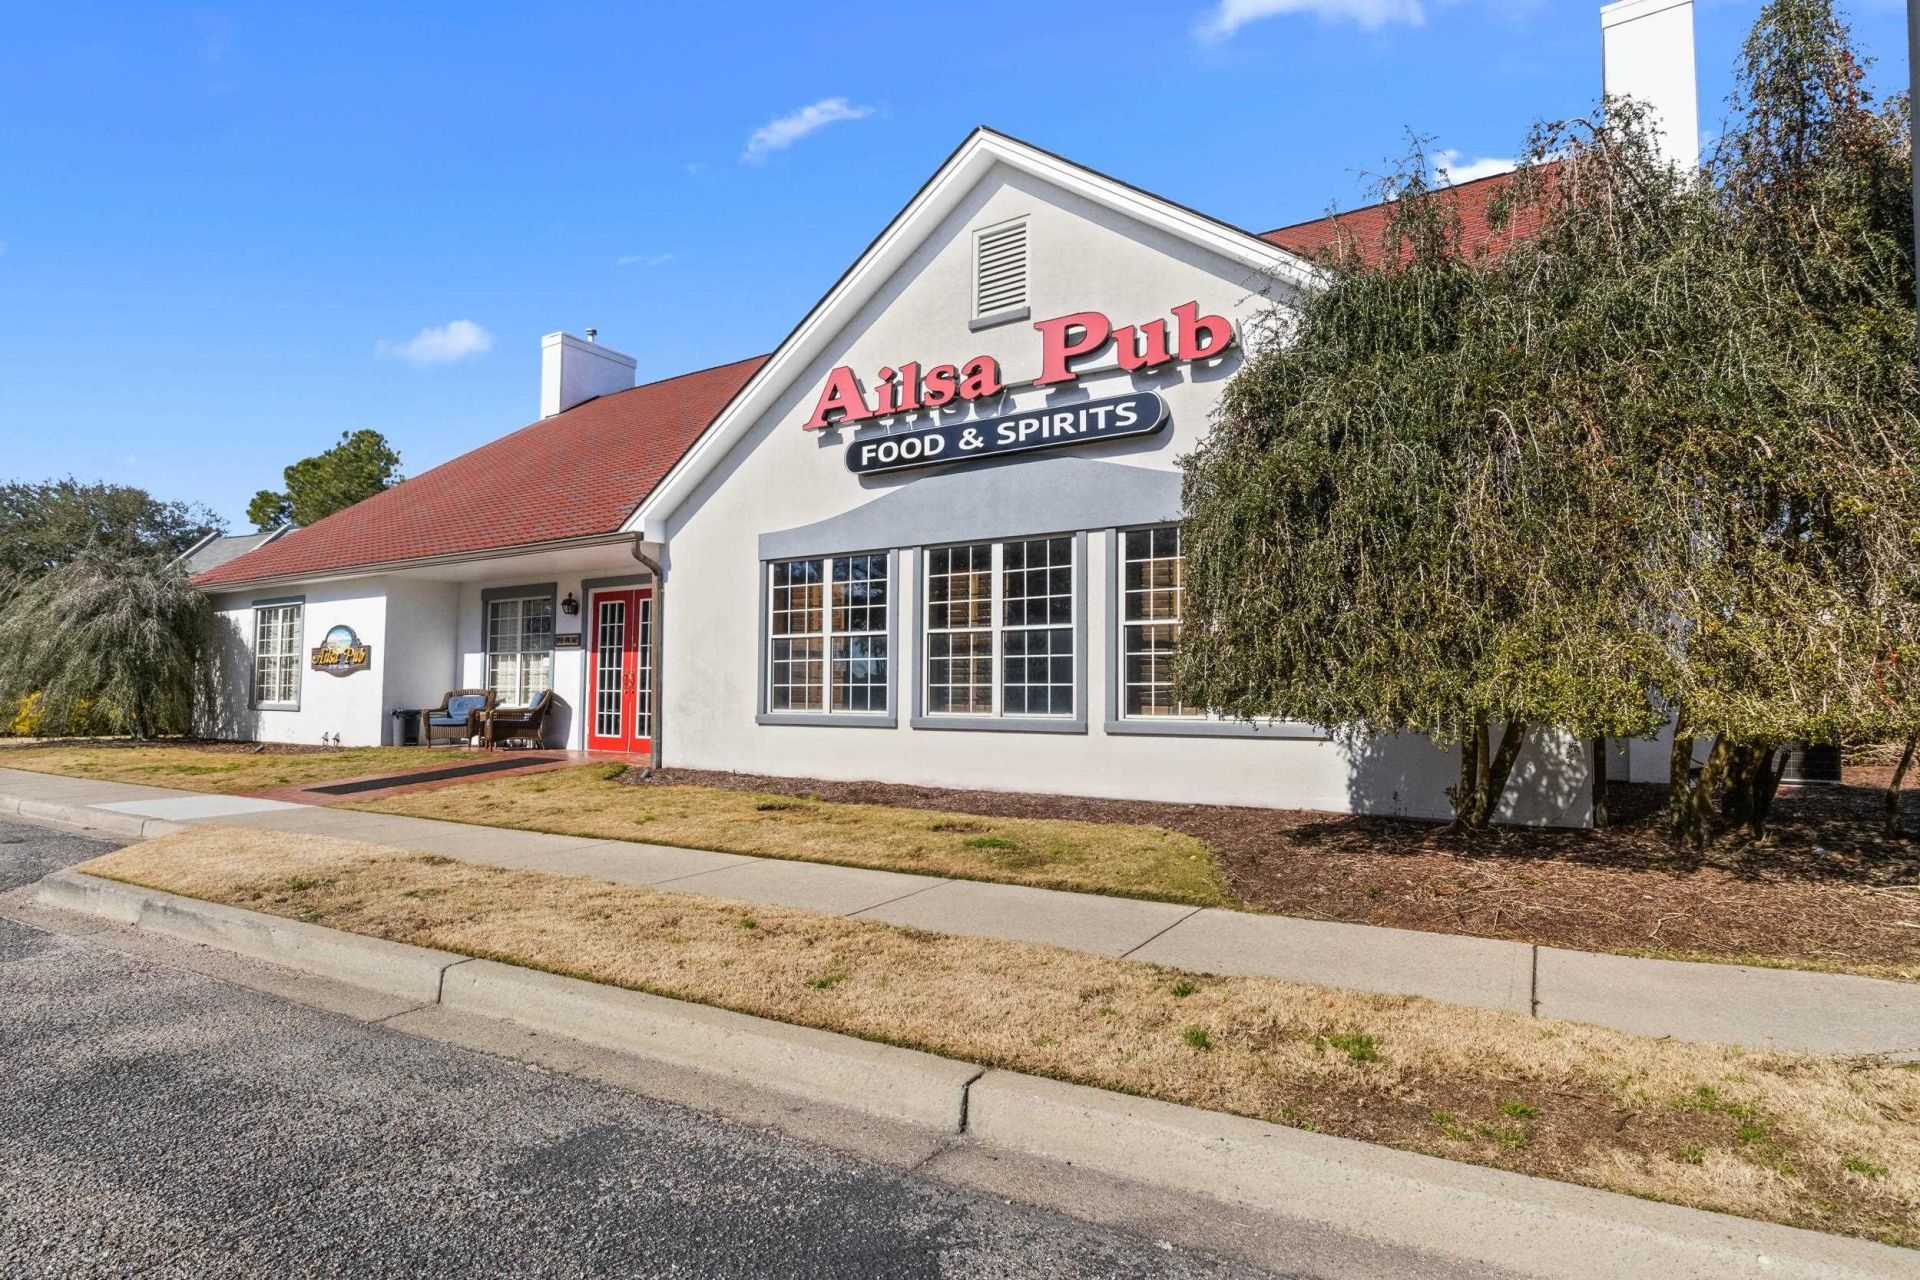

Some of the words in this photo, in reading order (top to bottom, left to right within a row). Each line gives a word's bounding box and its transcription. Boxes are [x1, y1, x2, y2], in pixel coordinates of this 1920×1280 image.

[802, 355, 1002, 431] Ailsa
[1033, 300, 1234, 387] Pub
[861, 433, 945, 466] FOOD
[958, 427, 984, 450] &
[997, 401, 1138, 445] SPIRITS
[311, 648, 339, 664] Ailsa
[344, 647, 366, 663] Pub
